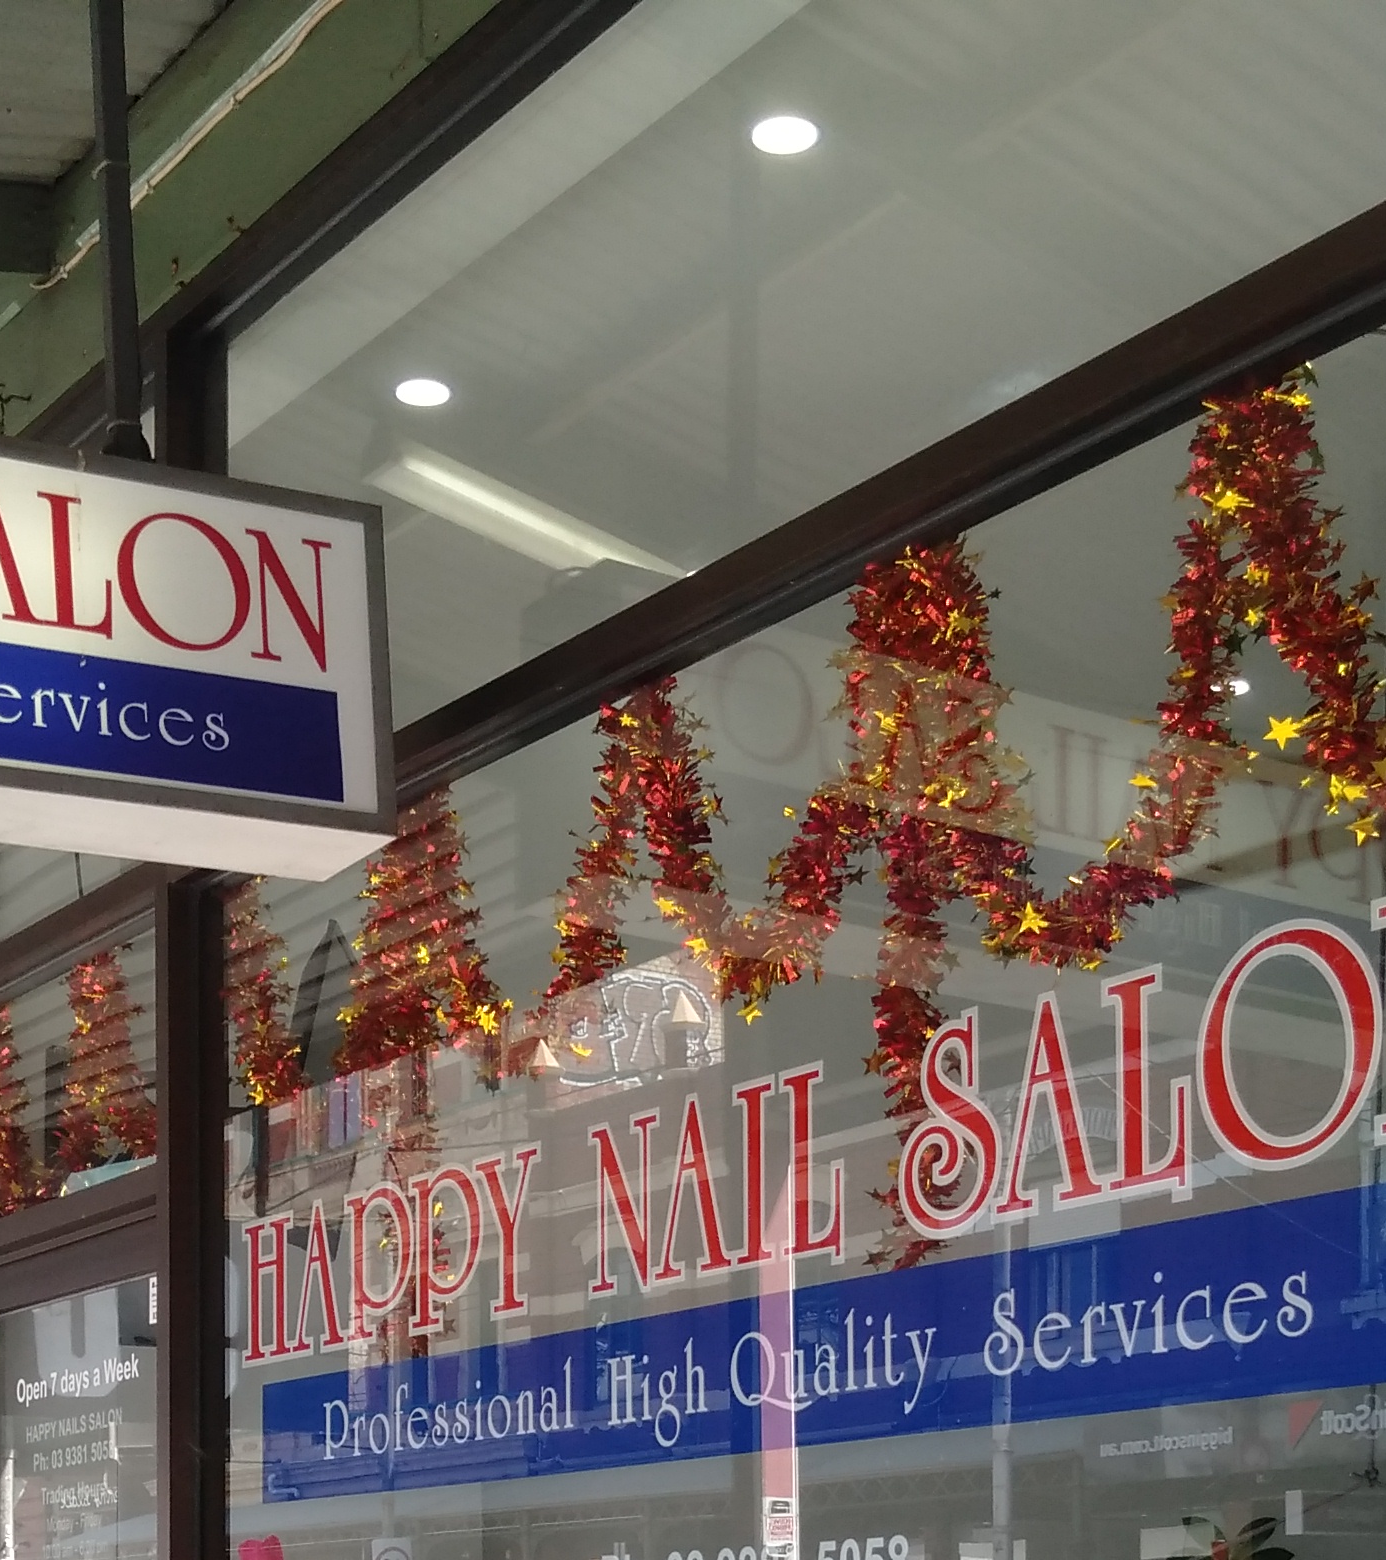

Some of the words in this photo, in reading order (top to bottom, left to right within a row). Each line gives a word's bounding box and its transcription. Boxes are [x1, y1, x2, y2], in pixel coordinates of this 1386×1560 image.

[243, 1141, 542, 1367] HAPPY
[590, 1061, 845, 1300] NAIL
[17, 1378, 48, 1408] Open
[50, 1371, 58, 1396] 7
[60, 1369, 90, 1398] days
[93, 1367, 101, 1387] a
[103, 1353, 140, 1384] Week
[324, 1356, 573, 1462] Professional
[608, 1337, 708, 1449] High
[731, 1308, 936, 1416] Quality
[984, 1270, 1315, 1379] Services
[26, 1420, 57, 1444] HAPPY
[58, 1414, 87, 1438] NAILS
[88, 1407, 124, 1432] SALON
[33, 1453, 49, 1472] Ph:
[51, 1449, 63, 1470] 03
[65, 1444, 88, 1467] 9381
